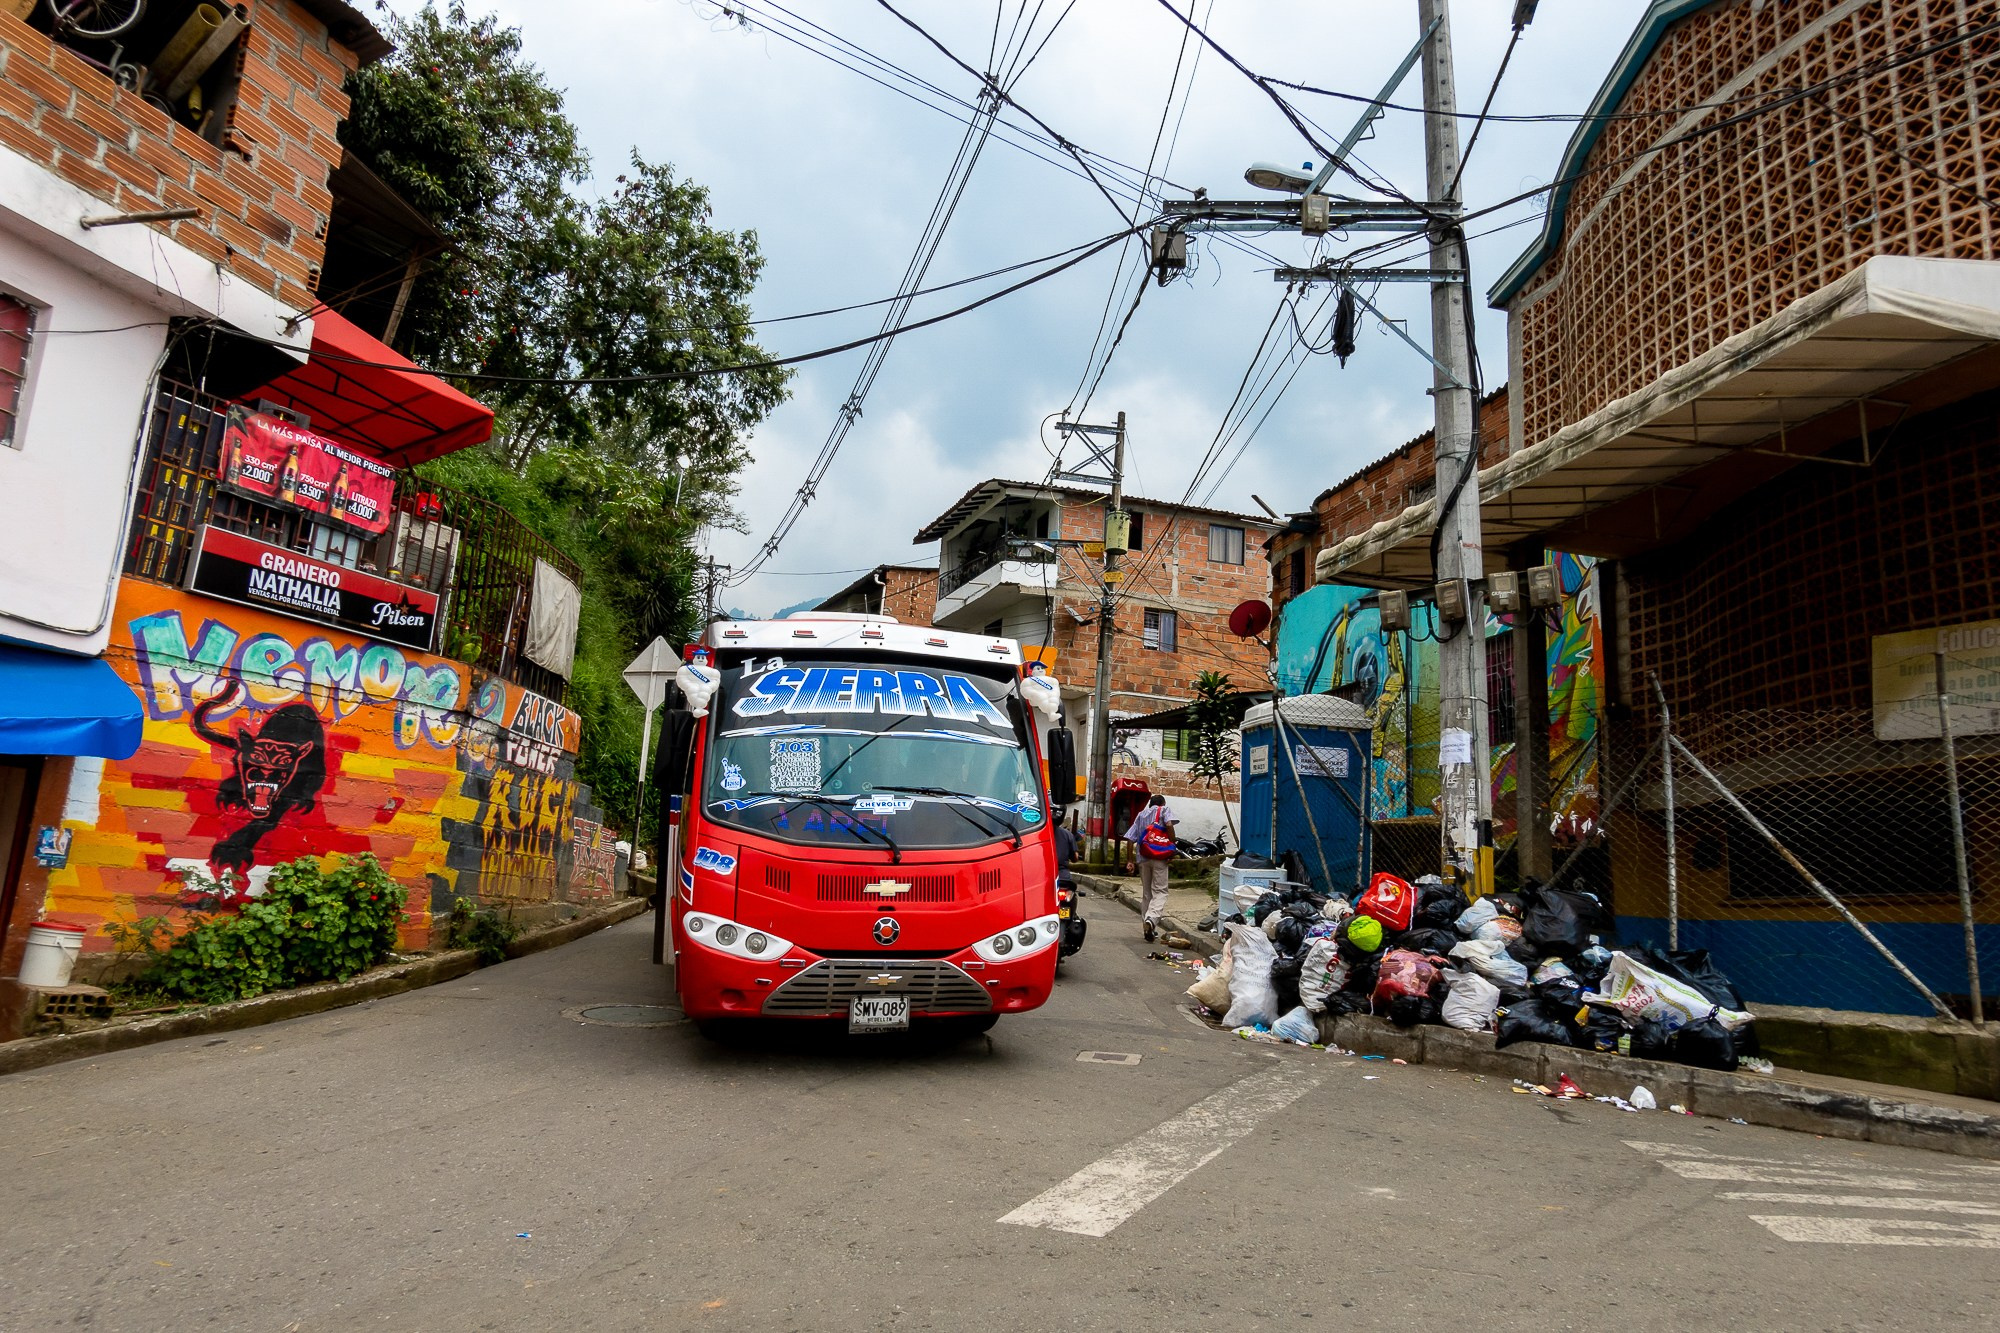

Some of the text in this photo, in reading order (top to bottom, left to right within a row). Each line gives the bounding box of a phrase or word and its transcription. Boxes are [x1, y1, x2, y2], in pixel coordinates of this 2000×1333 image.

[244, 454, 261, 467] 330
[257, 419, 391, 478] LA MÁS PAISA AL MEJOR PRECIO
[300, 473, 314, 485] 750
[351, 491, 378, 509] LITRAZO
[260, 552, 341, 588] GRANERO
[248, 587, 271, 599] VENTAS
[279, 596, 291, 604] POR
[291, 598, 311, 609] MAYOR
[323, 607, 340, 617] DETAL
[249, 569, 341, 610] NATHALIA
[371, 602, 425, 627] Pilsen
[739, 653, 787, 680] La
[732, 667, 1014, 729] SIERRA
[510, 690, 565, 748] BLACK
[777, 742, 814, 753] 103
[693, 846, 738, 876] 108
[854, 1001, 907, 1017] SMV-089
[1613, 983, 1646, 1012] COSTA
